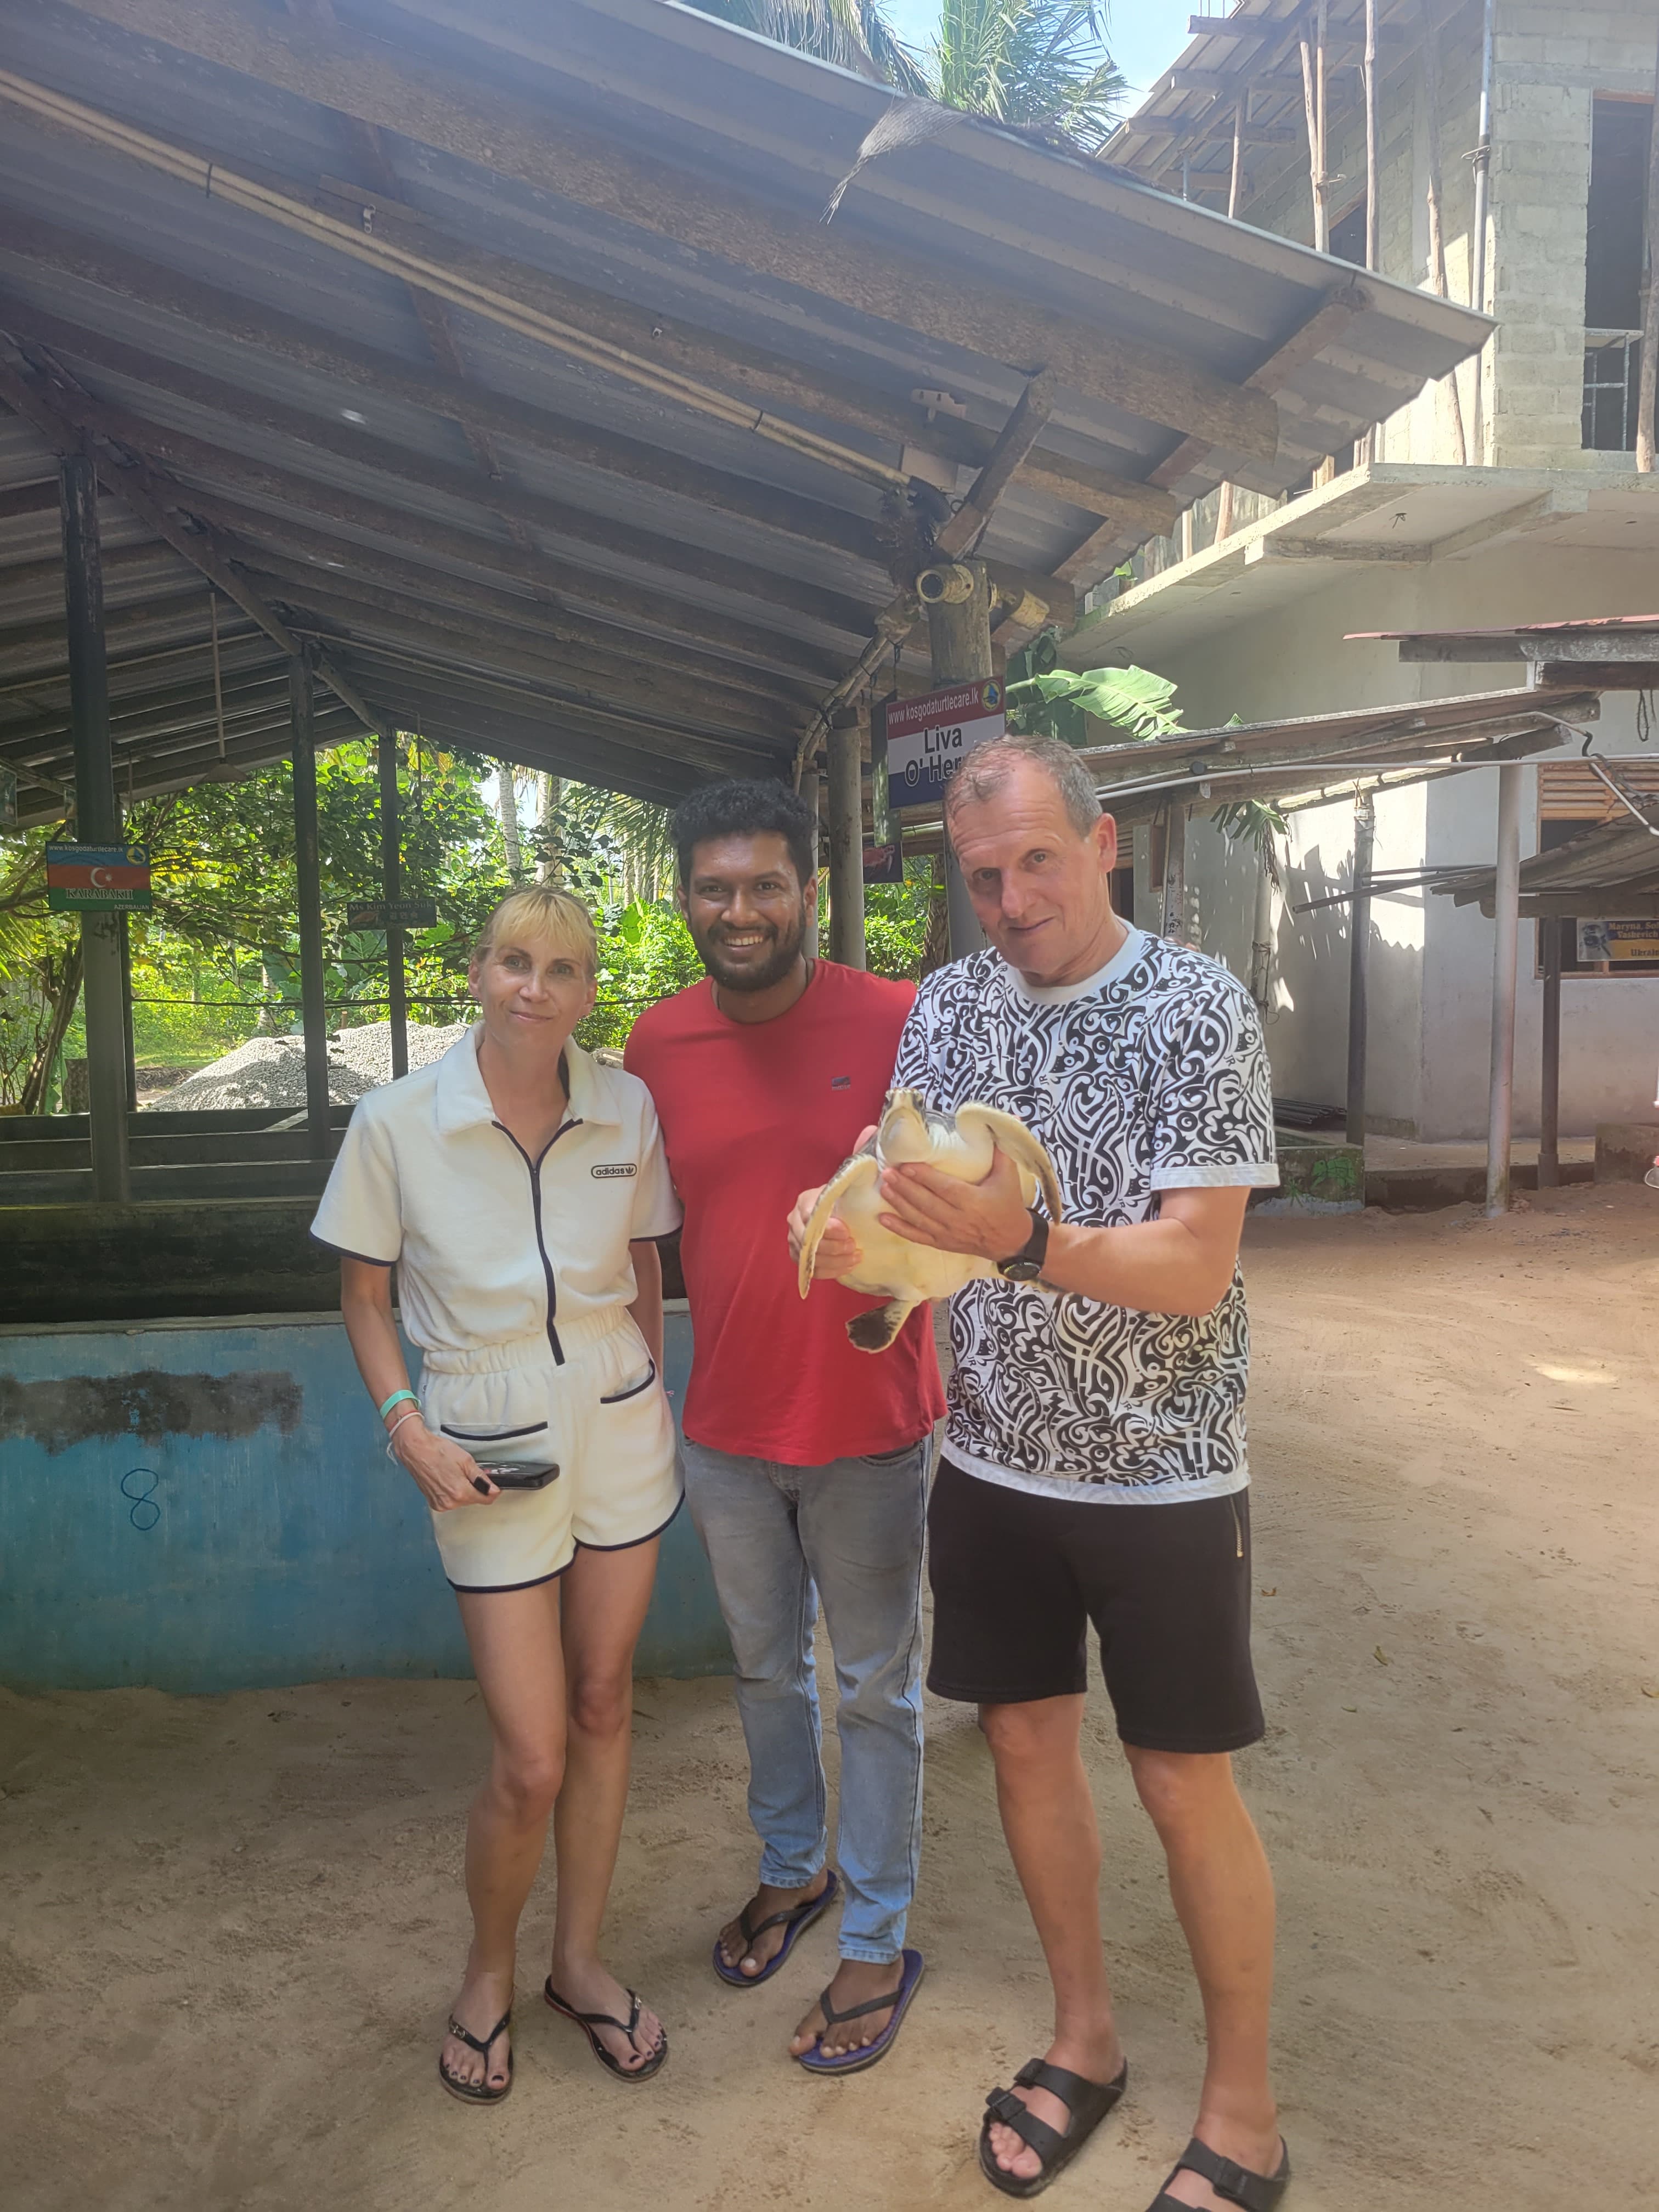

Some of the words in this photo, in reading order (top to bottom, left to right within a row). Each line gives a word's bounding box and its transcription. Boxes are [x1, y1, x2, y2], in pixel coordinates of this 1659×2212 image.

[924, 725, 962, 754] Liva
[905, 758, 923, 787] O'
[66, 888, 133, 900] KARABAKH
[414, 900, 431, 909] Suk
[596, 1167, 625, 1176] adidas
[121, 1468, 160, 1531] 8
